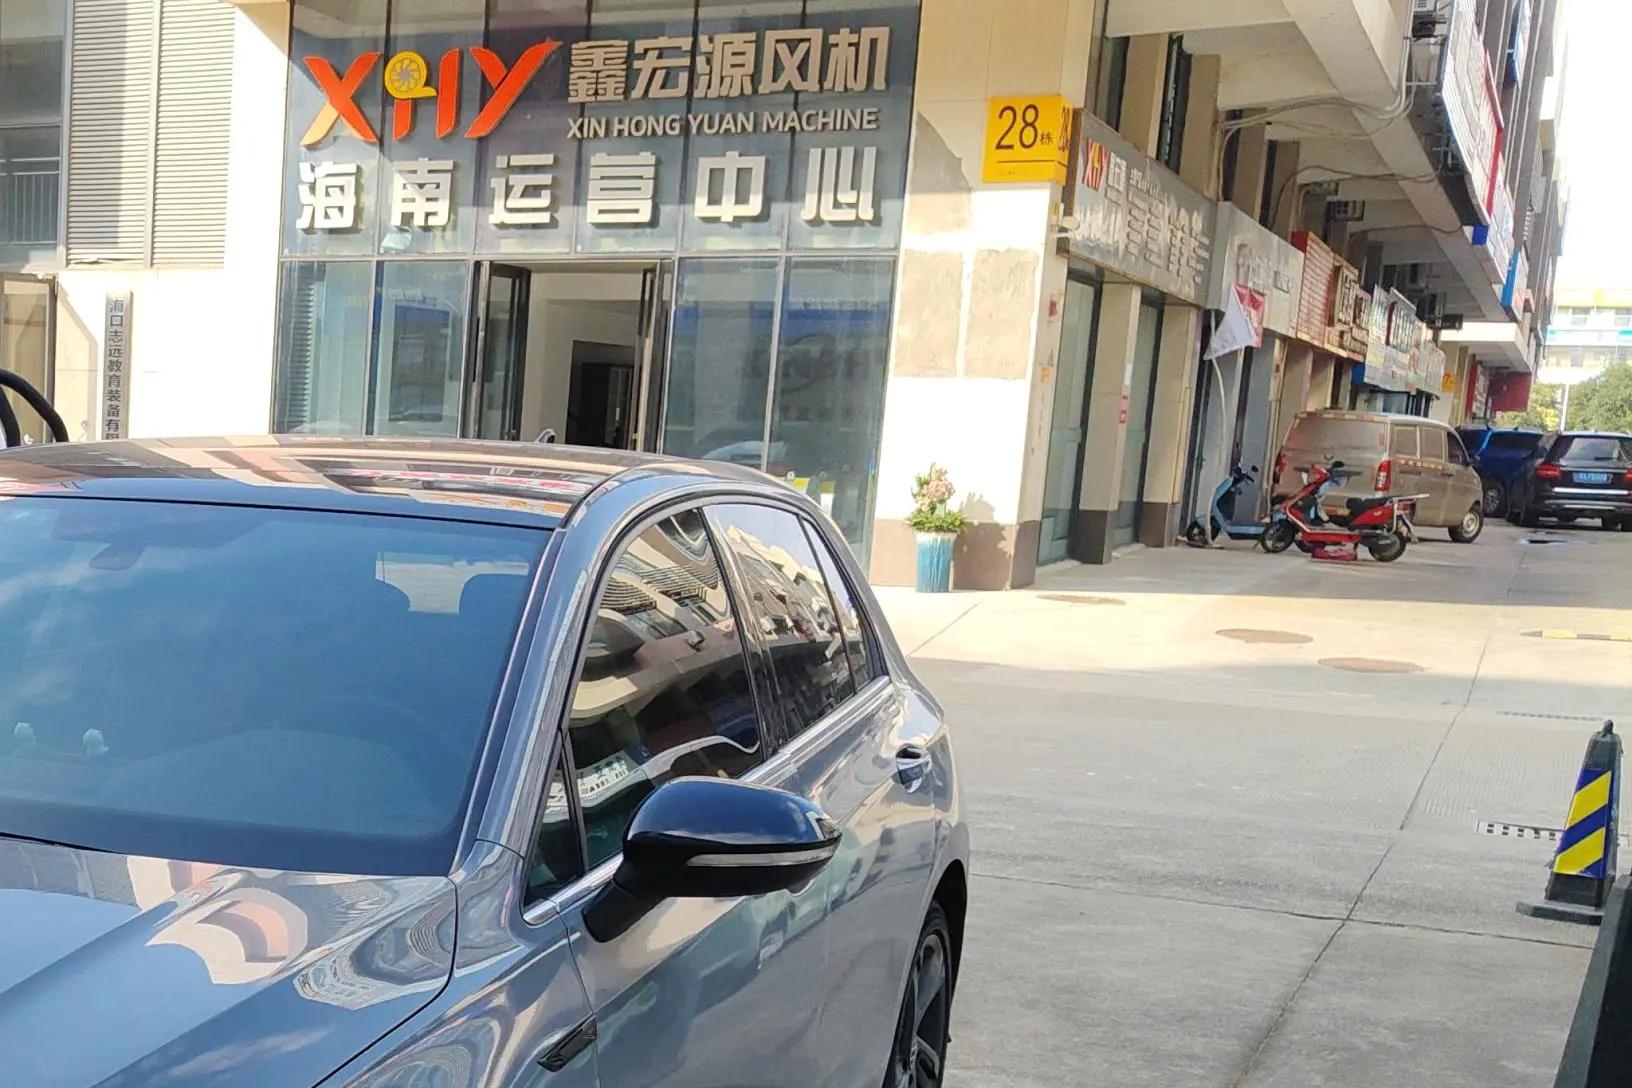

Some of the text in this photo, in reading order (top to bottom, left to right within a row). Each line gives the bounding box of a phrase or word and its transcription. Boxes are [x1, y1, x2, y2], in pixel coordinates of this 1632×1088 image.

[568, 27, 890, 103] 鑫宏源风机
[567, 107, 878, 139] XIN HONG YUAN MACHINE
[296, 146, 876, 230] 海南运营中心
